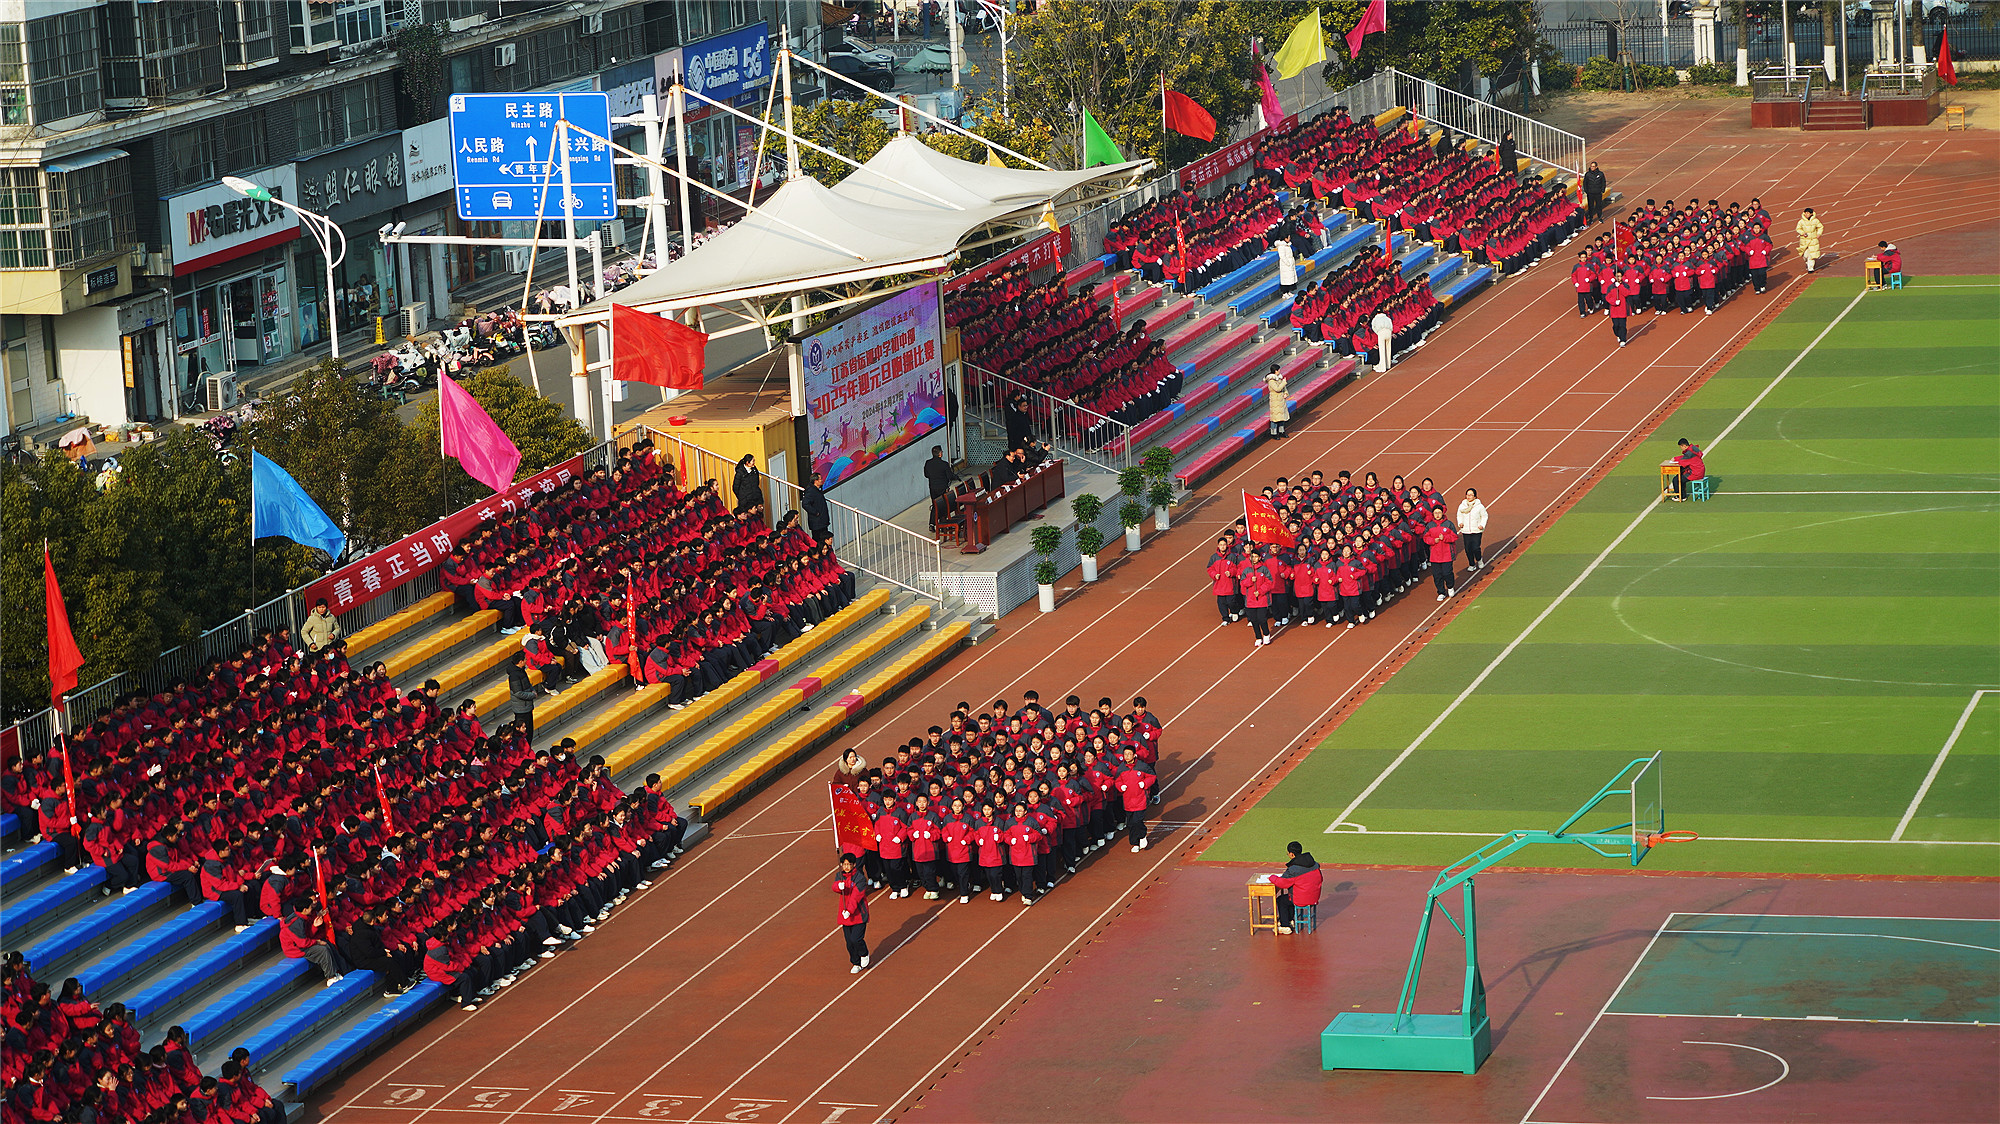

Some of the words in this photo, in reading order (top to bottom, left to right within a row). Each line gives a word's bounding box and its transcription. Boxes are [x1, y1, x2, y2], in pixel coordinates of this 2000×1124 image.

[705, 46, 739, 74] 中国移动
[454, 97, 462, 105] 北
[505, 101, 554, 119] 民主路
[511, 121, 531, 129] Minzhu
[458, 137, 505, 154] 人民路
[492, 155, 500, 163] Rd
[568, 155, 589, 164] ongxing
[515, 164, 550, 175] 青年路
[325, 152, 403, 210] 盟仁眼镜
[223, 186, 285, 235] 晨光文具
[831, 327, 916, 384] 江苏省运河中学初中部
[812, 338, 935, 420] 2025年迎元旦跑操比赛
[861, 390, 904, 420] 2024年12月27日
[333, 529, 454, 607] 青春正当时
[383, 1087, 425, 1105] 6
[467, 1091, 511, 1108] 5
[552, 1094, 594, 1111] 4
[638, 1098, 682, 1117] 3
[725, 1102, 772, 1120] 2
[821, 1106, 857, 1124] 1
